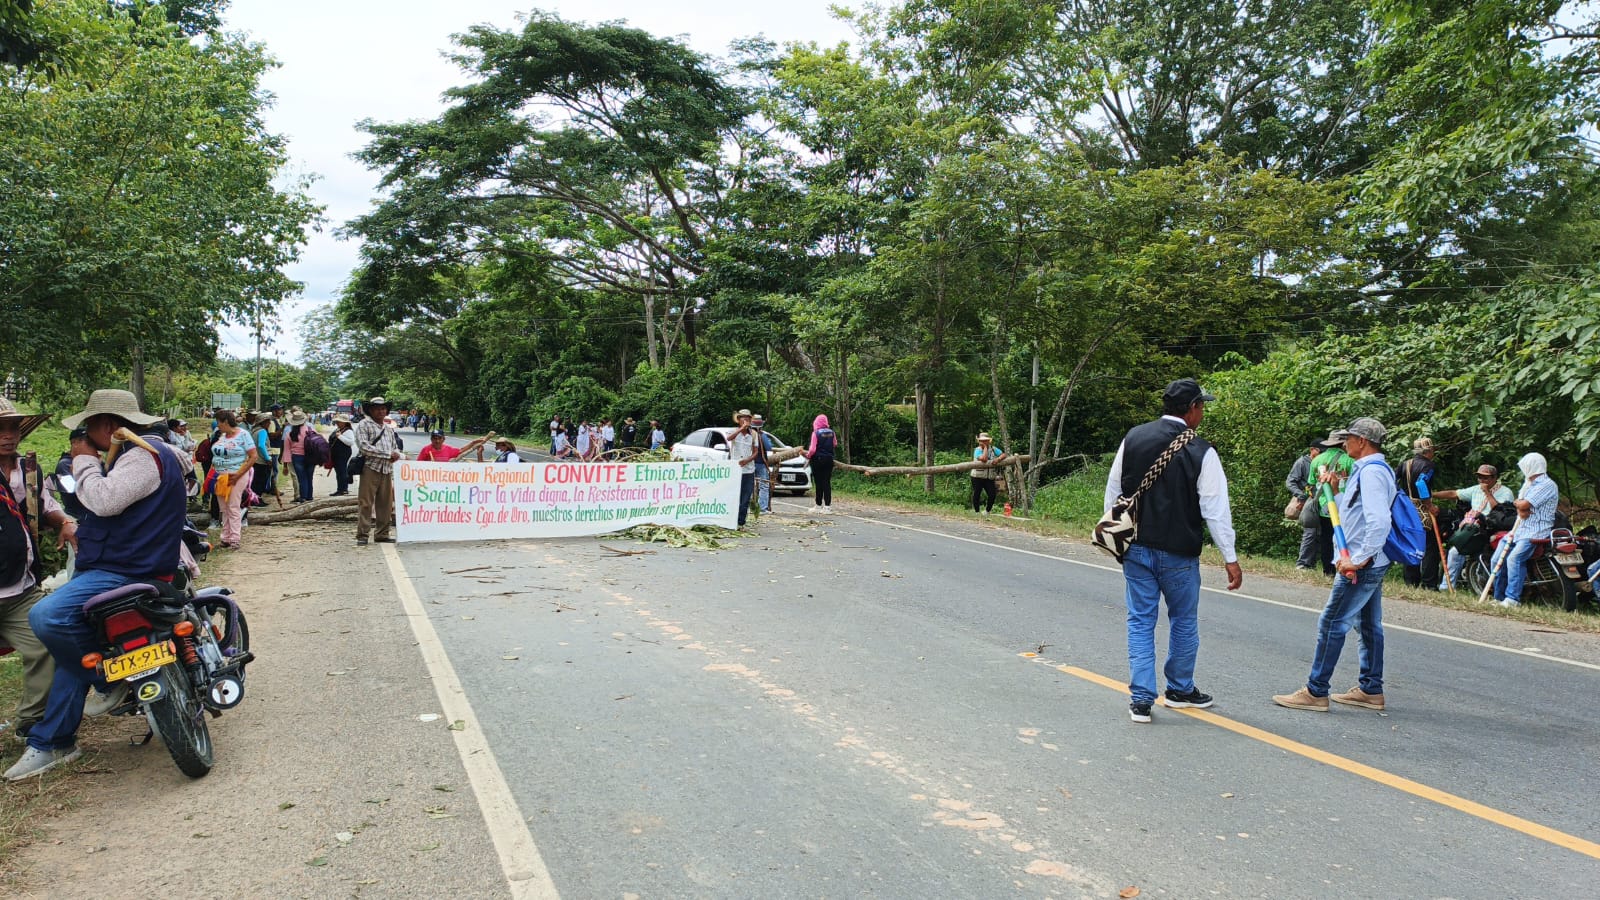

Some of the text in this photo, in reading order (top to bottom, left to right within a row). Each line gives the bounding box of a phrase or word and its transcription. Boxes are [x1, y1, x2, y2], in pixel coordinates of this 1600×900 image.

[401, 463, 479, 487] Organización
[484, 464, 535, 487] Regional
[544, 464, 627, 483] CONVITE
[404, 489, 413, 507] y
[469, 486, 492, 504] Por
[496, 485, 507, 503] la
[511, 486, 535, 503] vida
[539, 485, 571, 507] digna,
[573, 486, 585, 502] la
[588, 485, 648, 503] Resistencia
[652, 487, 660, 505] y
[663, 483, 673, 499] la
[401, 504, 472, 525] Autoridades
[498, 505, 509, 523] de
[532, 505, 573, 522] nuestros
[575, 504, 614, 521] derechos
[616, 508, 628, 520] no
[628, 502, 659, 521] pueden
[660, 504, 676, 516] ser
[676, 498, 729, 520] pisoteados.
[109, 655, 137, 675] CTX
